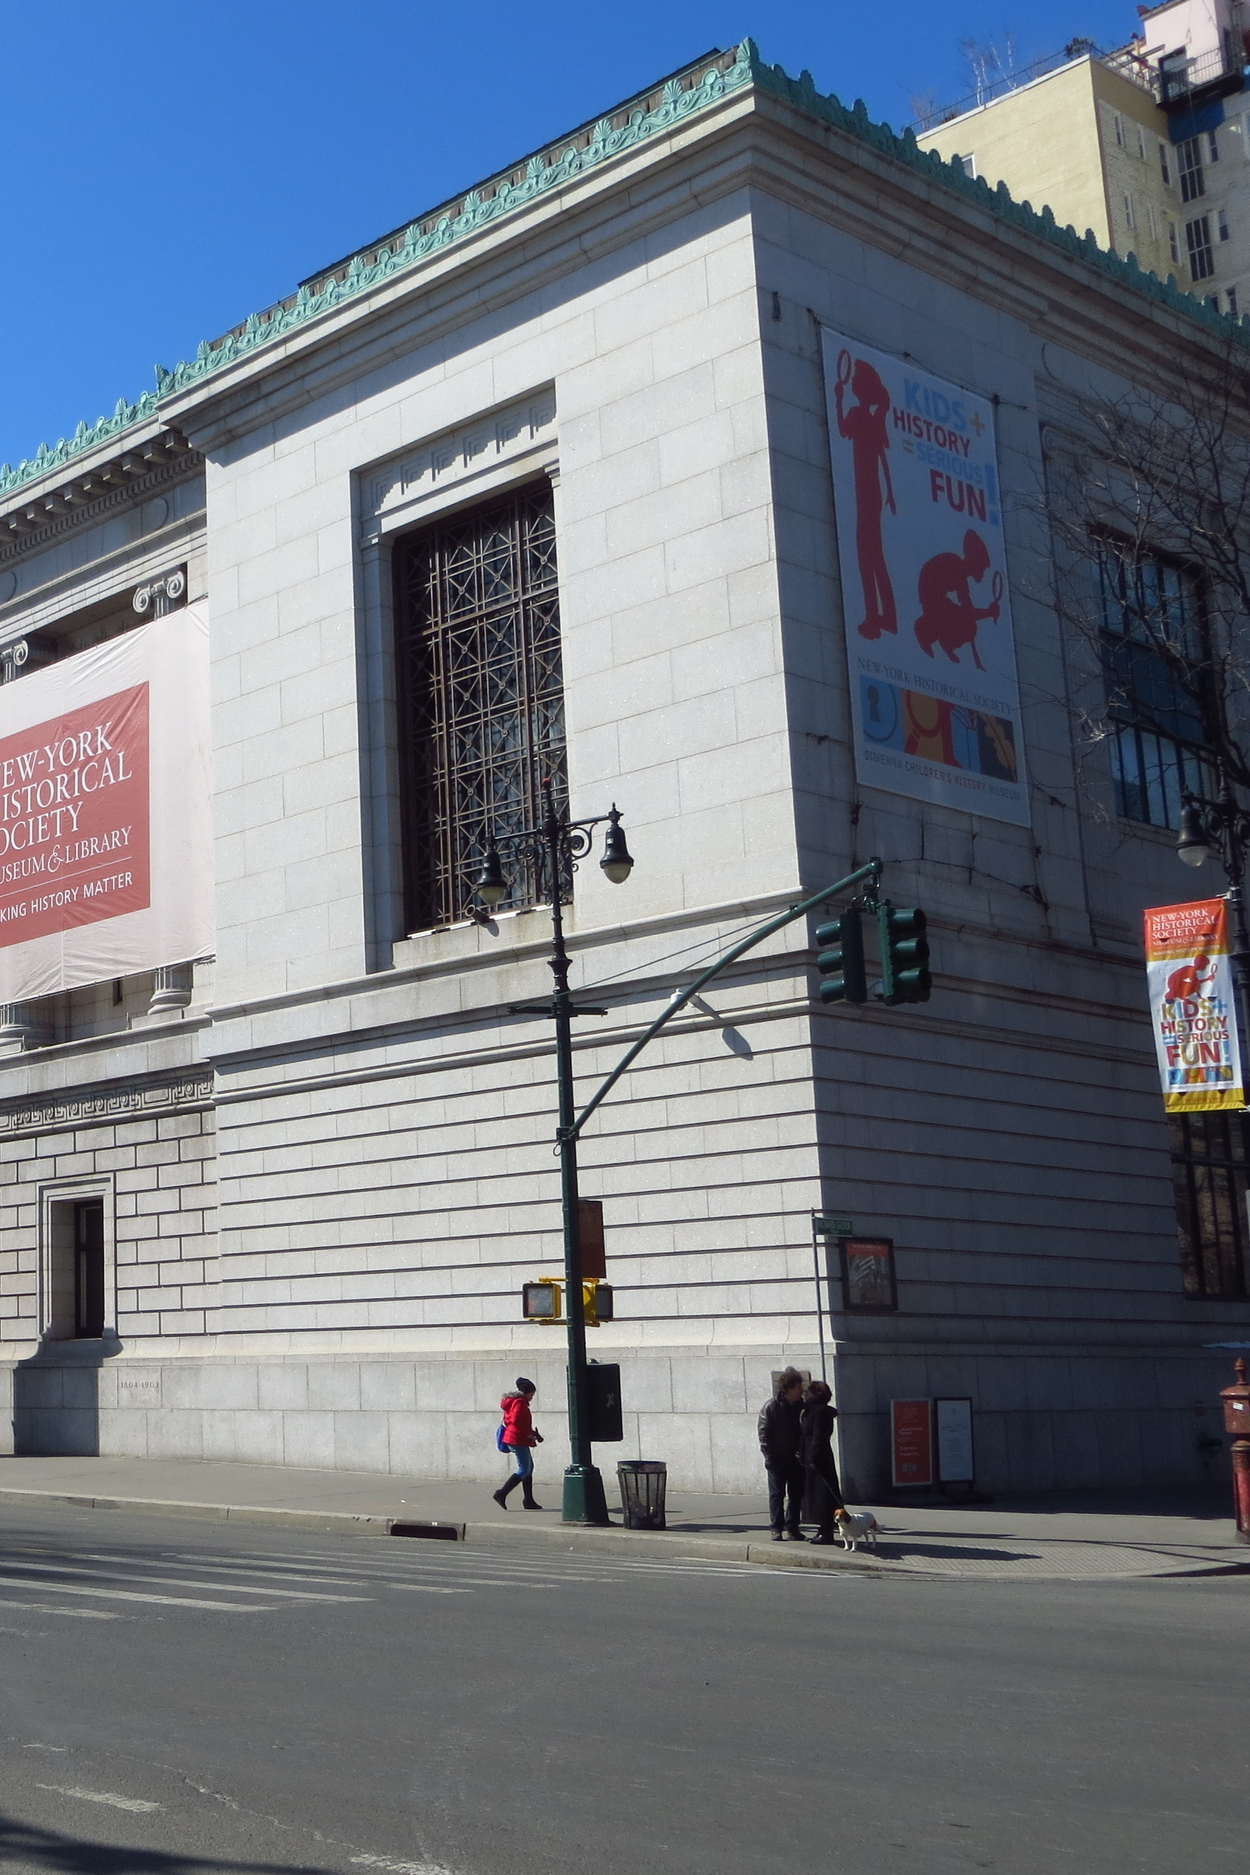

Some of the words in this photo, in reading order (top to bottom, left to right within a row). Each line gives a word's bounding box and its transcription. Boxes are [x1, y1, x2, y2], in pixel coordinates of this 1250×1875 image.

[903, 377, 967, 432] KIDS
[892, 406, 971, 458] HISTORY
[916, 441, 982, 485] SERIOUS
[856, 656, 911, 684] NEW-YORK
[914, 674, 971, 704] HISTORICAL
[973, 693, 1013, 715] SOCIETY
[954, 774, 986, 791] HISTORY
[47, 844, 65, 873] &
[65, 825, 132, 864] LIBRARY
[31, 886, 80, 914] HISTORY
[83, 871, 133, 899] MATTER
[1152, 908, 1209, 923] NEW-YORK
[1152, 915, 1218, 931] HISTORICAL
[1152, 926, 1197, 940] SOCIETY
[1160, 998, 1213, 1020] KIDS
[1160, 1015, 1228, 1035] HISTORY
[1177, 1029, 1229, 1044] SERIOUS
[1166, 1040, 1230, 1067] FUN!
